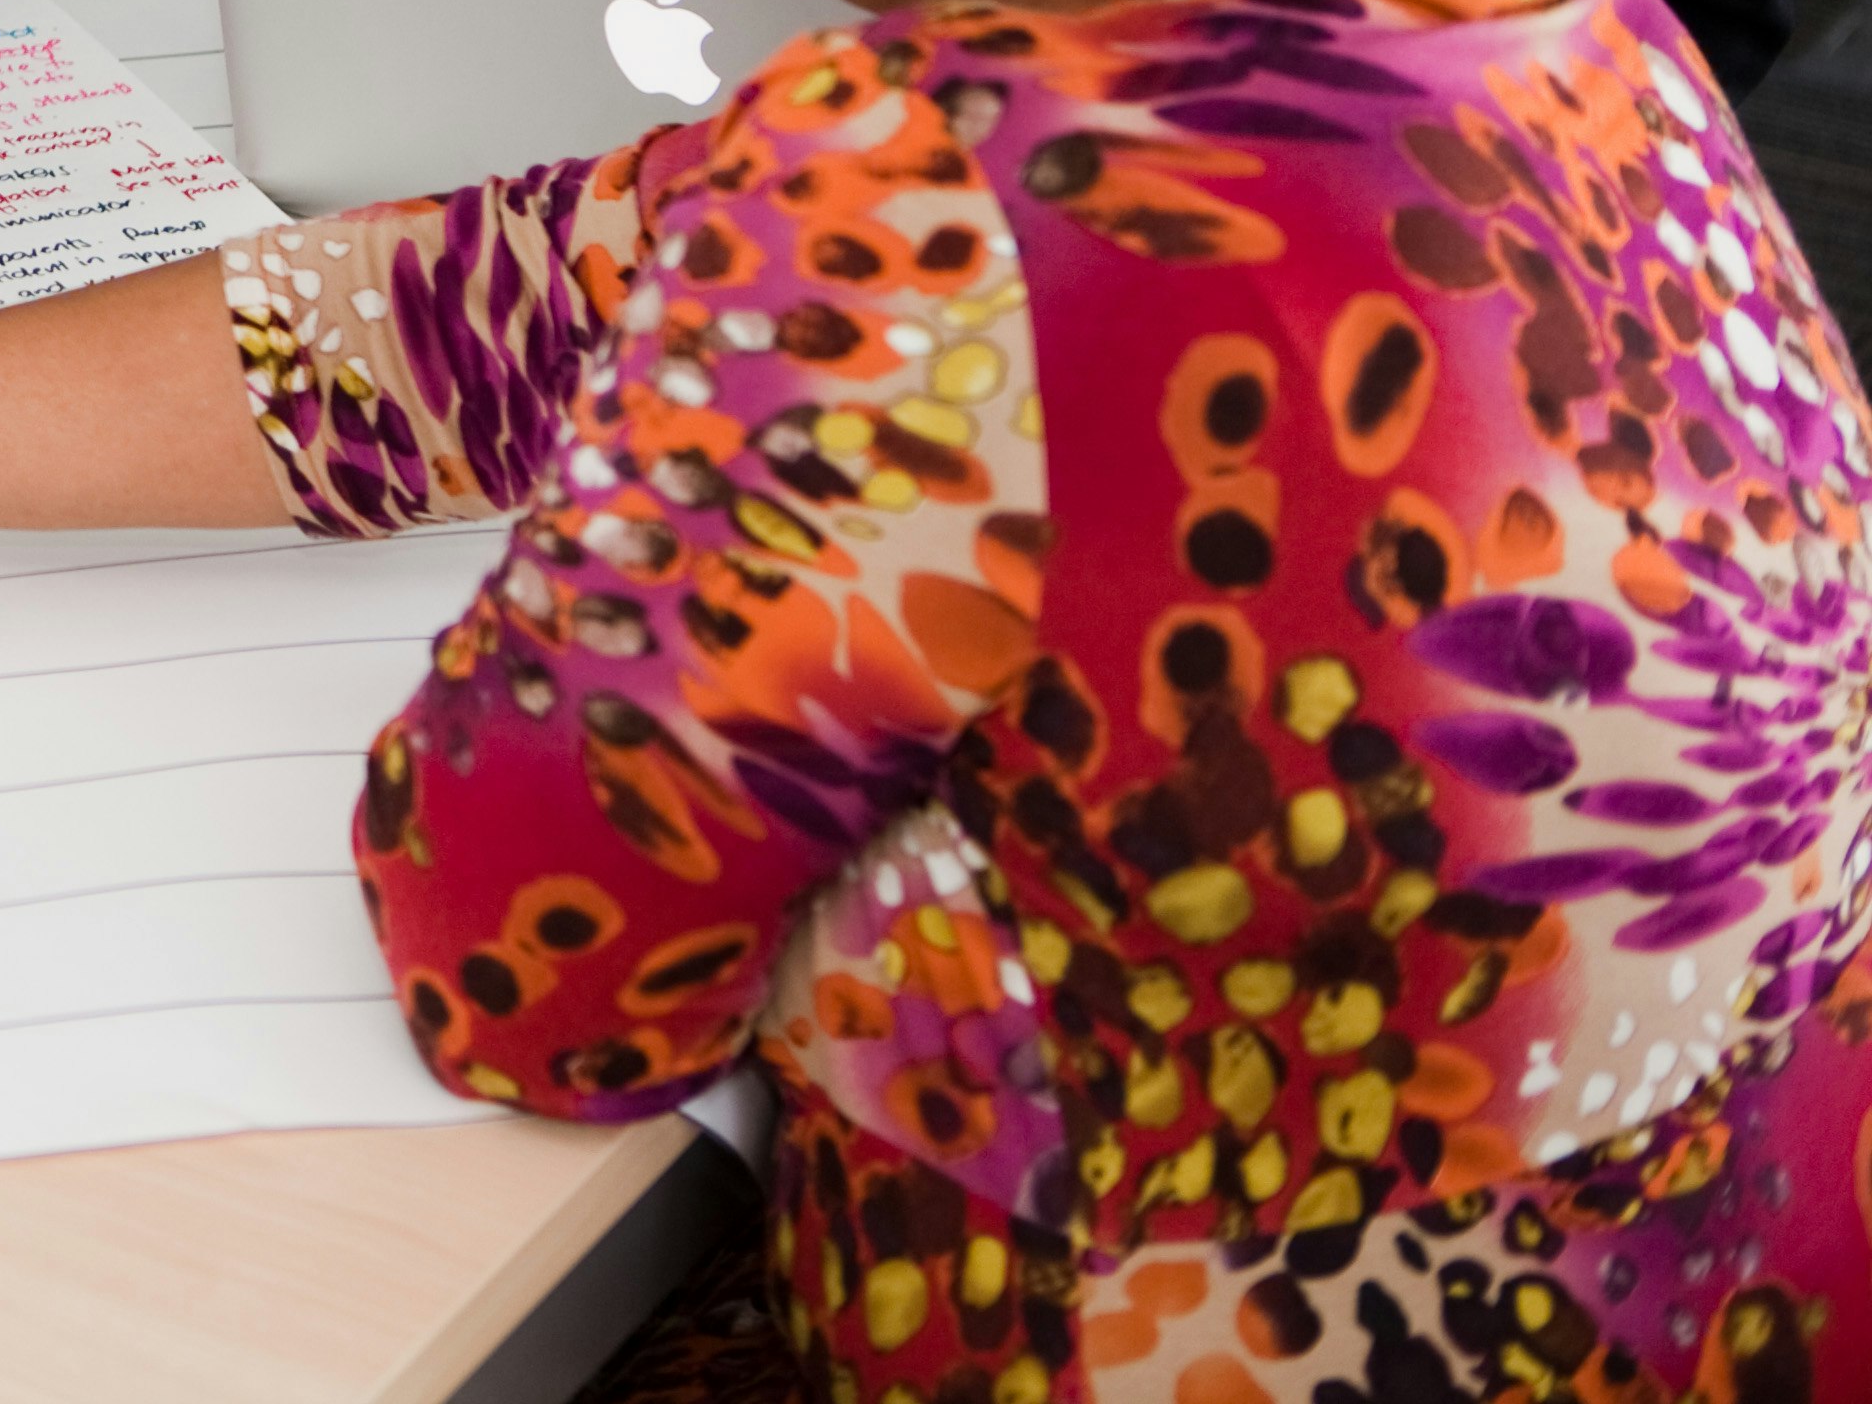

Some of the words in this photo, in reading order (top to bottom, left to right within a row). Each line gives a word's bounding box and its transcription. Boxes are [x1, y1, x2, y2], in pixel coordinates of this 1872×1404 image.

[117, 119, 142, 129] in
[116, 179, 156, 193] see
[163, 172, 204, 187] the
[181, 178, 242, 202] point
[75, 255, 105, 268] in
[18, 281, 68, 298] and
